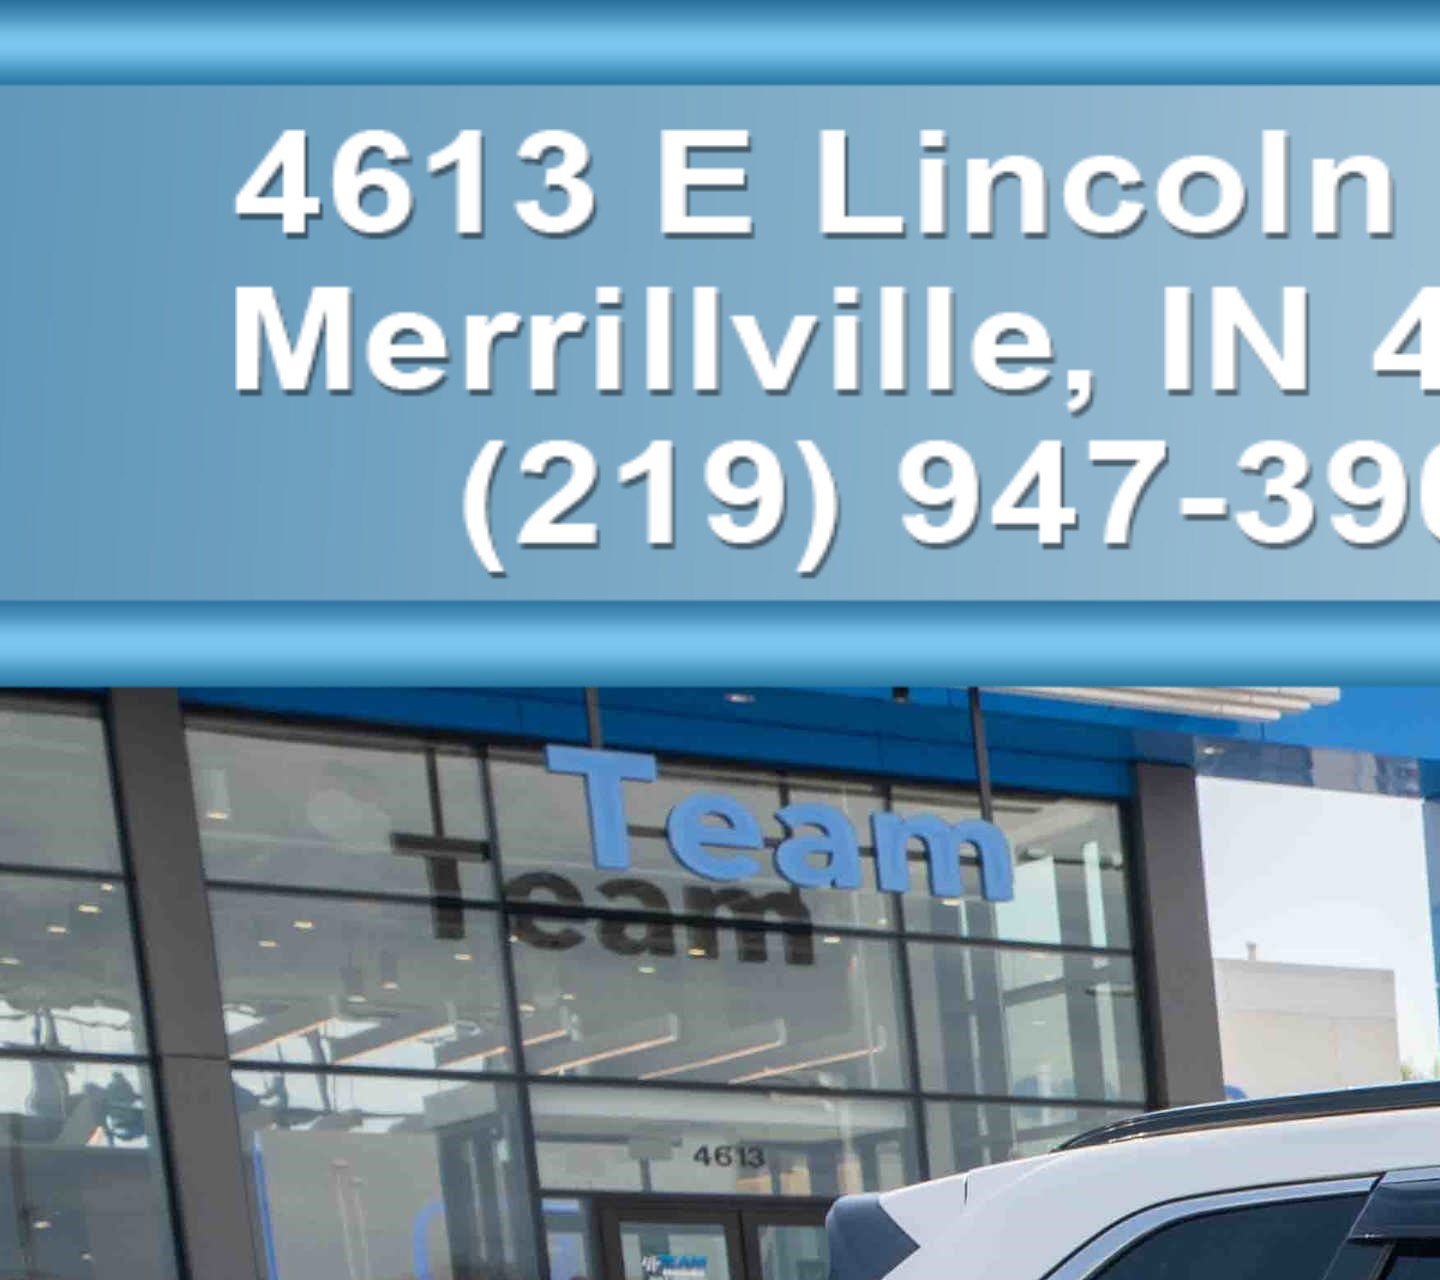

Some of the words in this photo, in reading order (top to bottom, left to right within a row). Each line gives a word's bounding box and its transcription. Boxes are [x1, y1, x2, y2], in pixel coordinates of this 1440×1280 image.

[546, 744, 1014, 900] Team
[390, 831, 815, 966] Team
[693, 1144, 766, 1168] 4613
